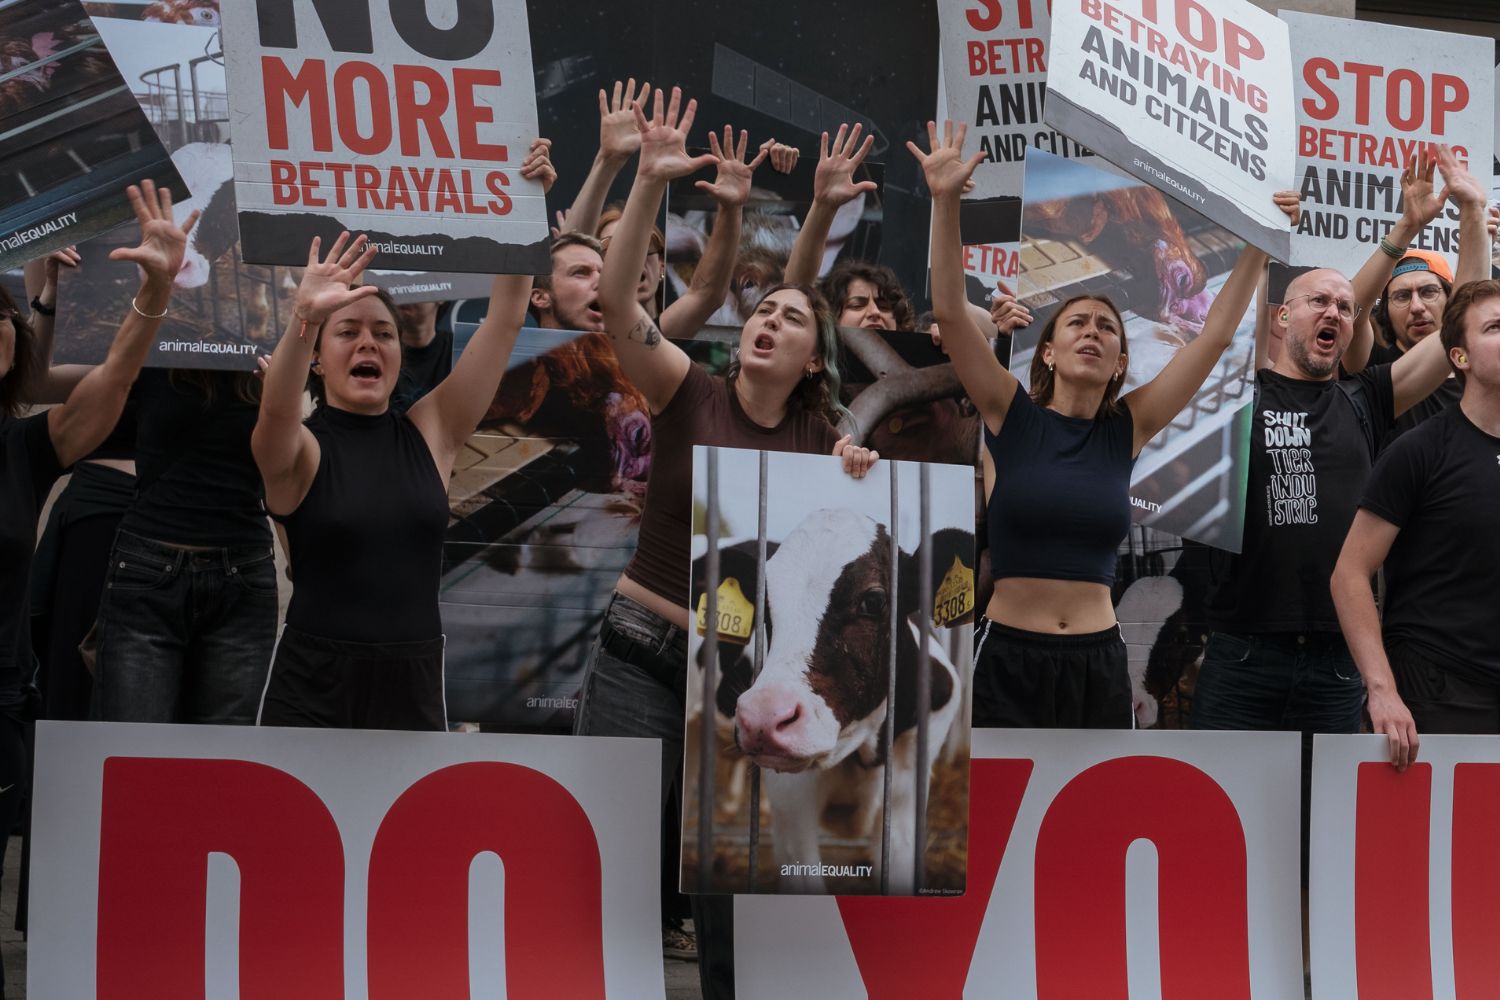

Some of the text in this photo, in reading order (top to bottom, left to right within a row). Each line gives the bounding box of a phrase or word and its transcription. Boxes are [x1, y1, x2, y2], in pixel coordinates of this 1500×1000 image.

[1080, 0, 1268, 114] BETRAYING
[1080, 25, 1269, 151] ANIMALS
[1302, 57, 1470, 136] STOP
[261, 55, 508, 162] MORE
[1078, 59, 1267, 182] AND CITIZENS
[979, 133, 1026, 164] AND
[270, 159, 513, 216] BETRAYALS
[1133, 157, 1206, 205] animalEQUALITY
[1297, 209, 1349, 240] AND
[360, 239, 444, 255] nimalEQUALITY
[159, 338, 258, 355] animalEQUALITY
[1263, 410, 1309, 429] SHUT
[1264, 426, 1312, 448] DOWN
[1129, 495, 1163, 514] UALITY
[96, 755, 607, 1000] DO
[780, 860, 873, 878] animalEQUALITY
